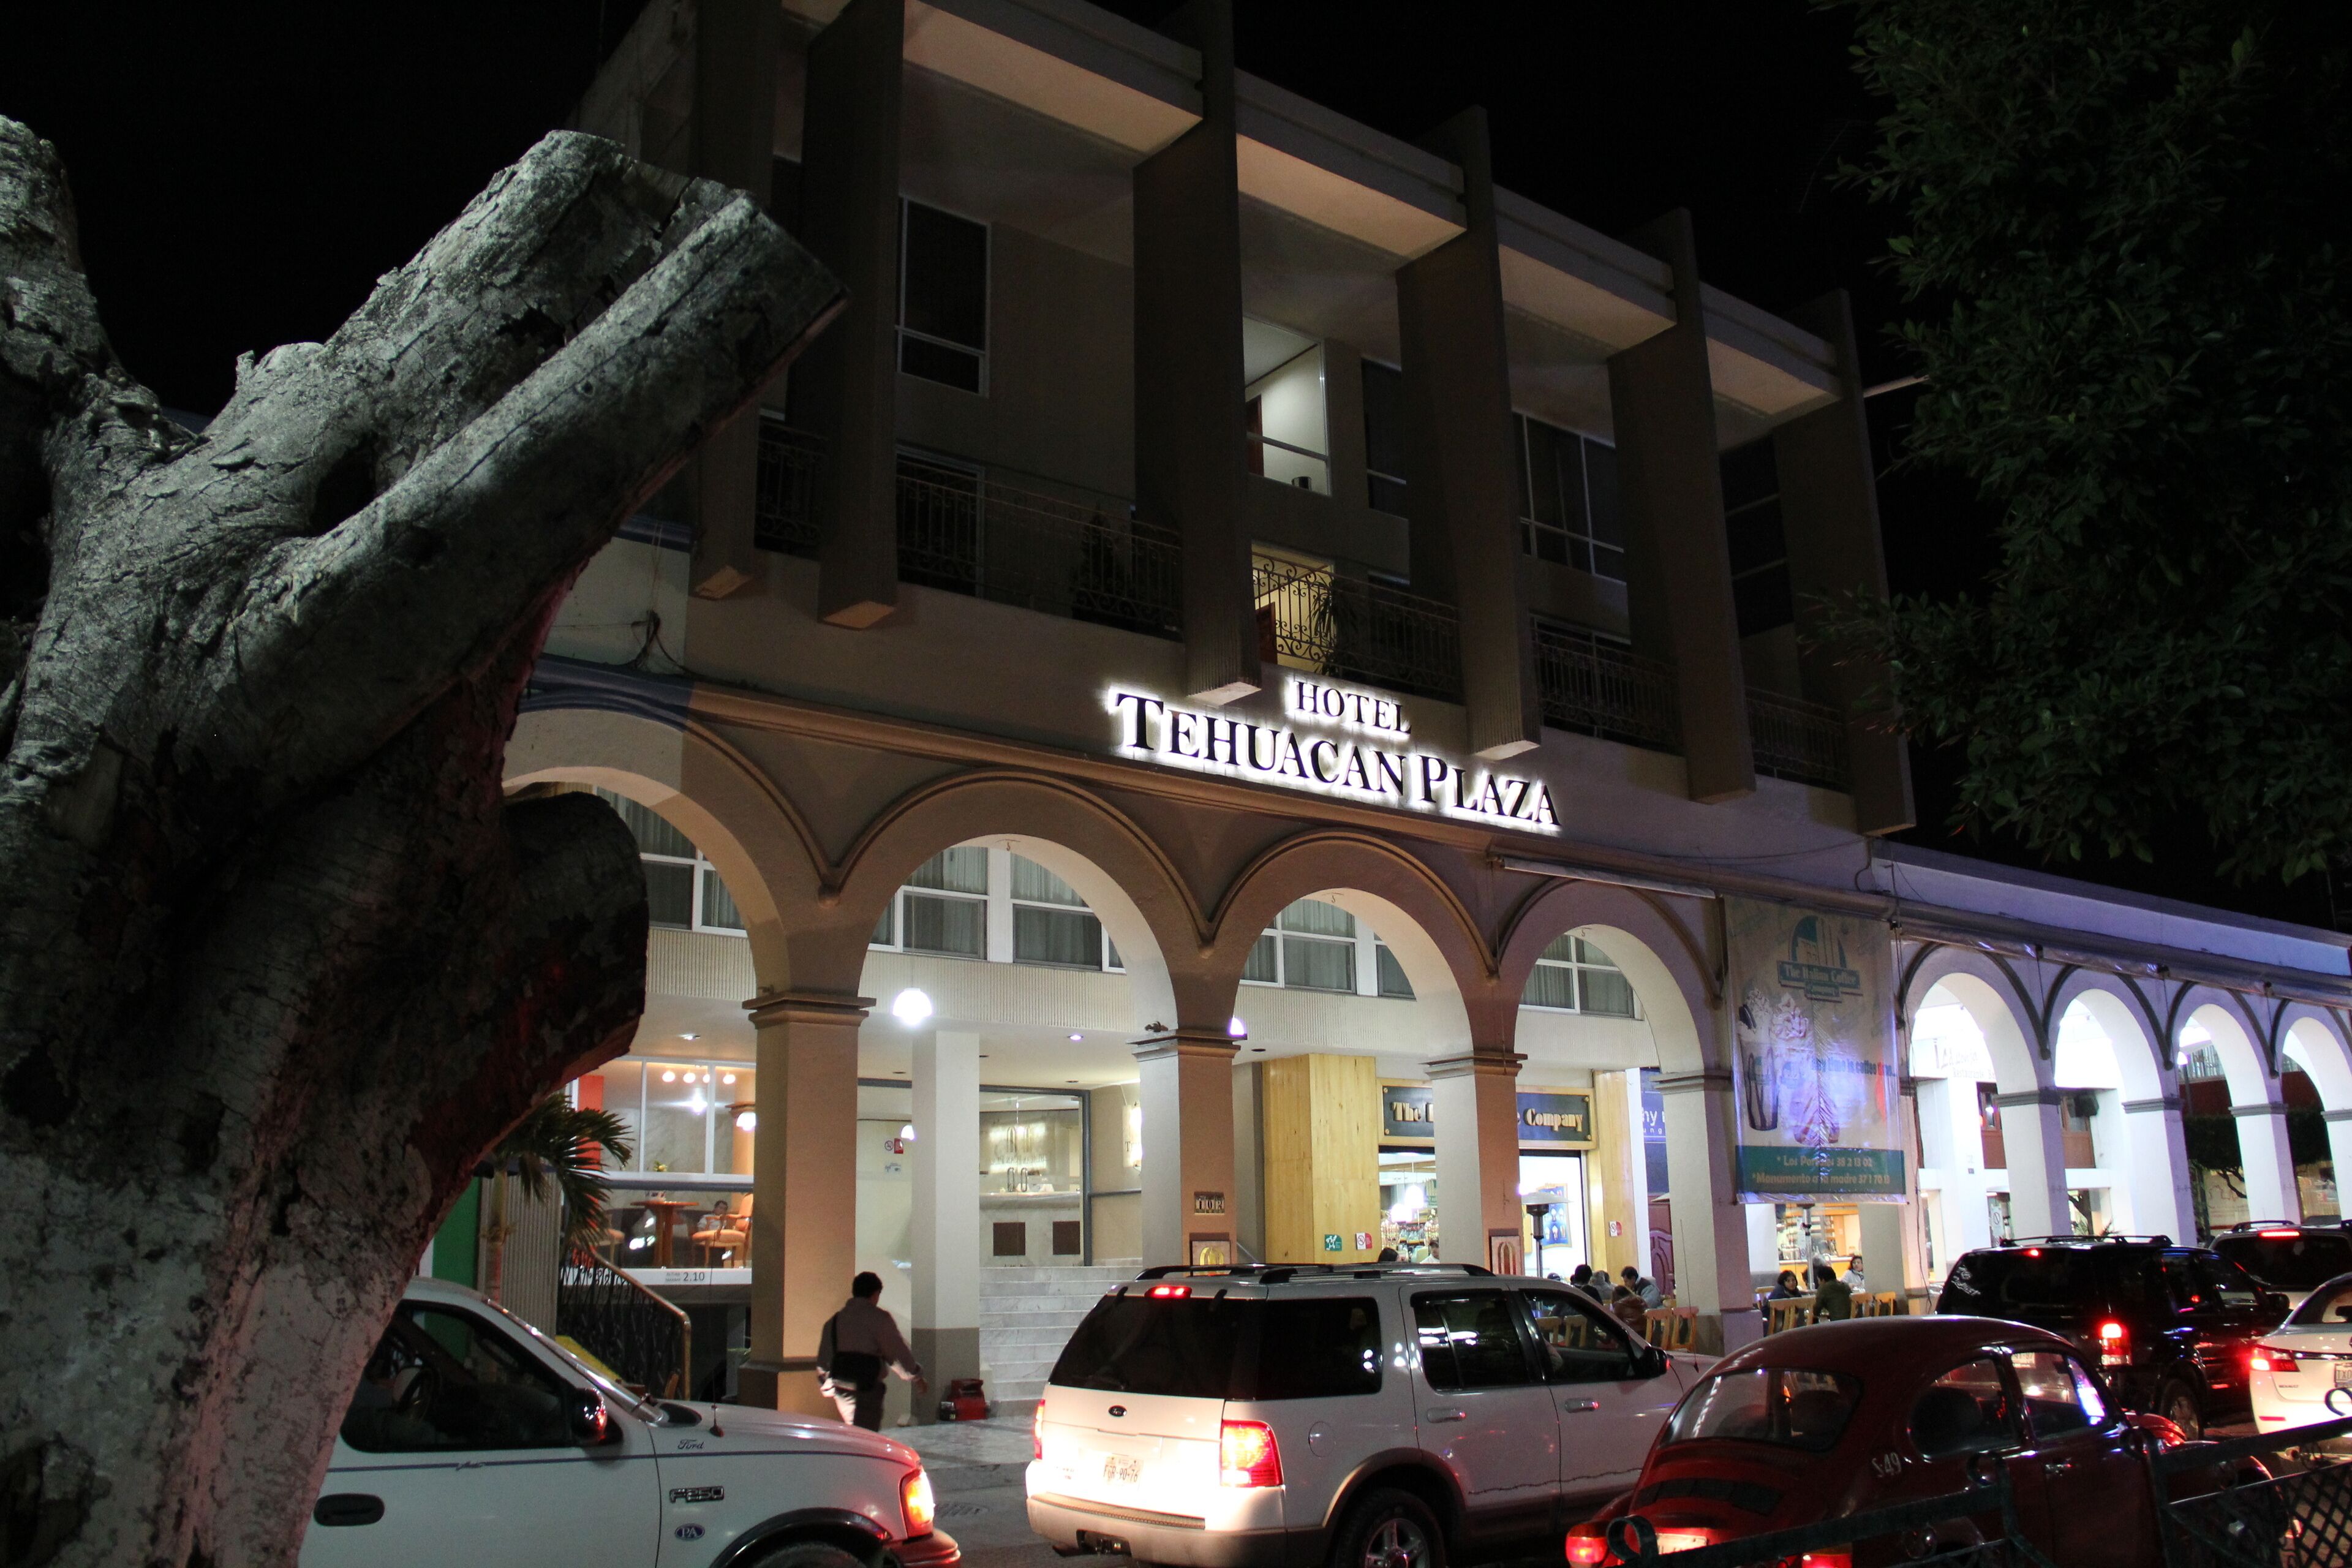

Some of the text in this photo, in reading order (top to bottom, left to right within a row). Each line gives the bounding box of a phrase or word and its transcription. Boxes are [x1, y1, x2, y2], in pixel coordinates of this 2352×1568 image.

[1294, 680, 1412, 734] HOTEL
[1114, 693, 1561, 826] TEHUACAN PLAZA
[1390, 1101, 1422, 1122] The
[1525, 1107, 1583, 1132] Company
[683, 1272, 705, 1281] 2.10
[677, 1439, 704, 1450] Ford
